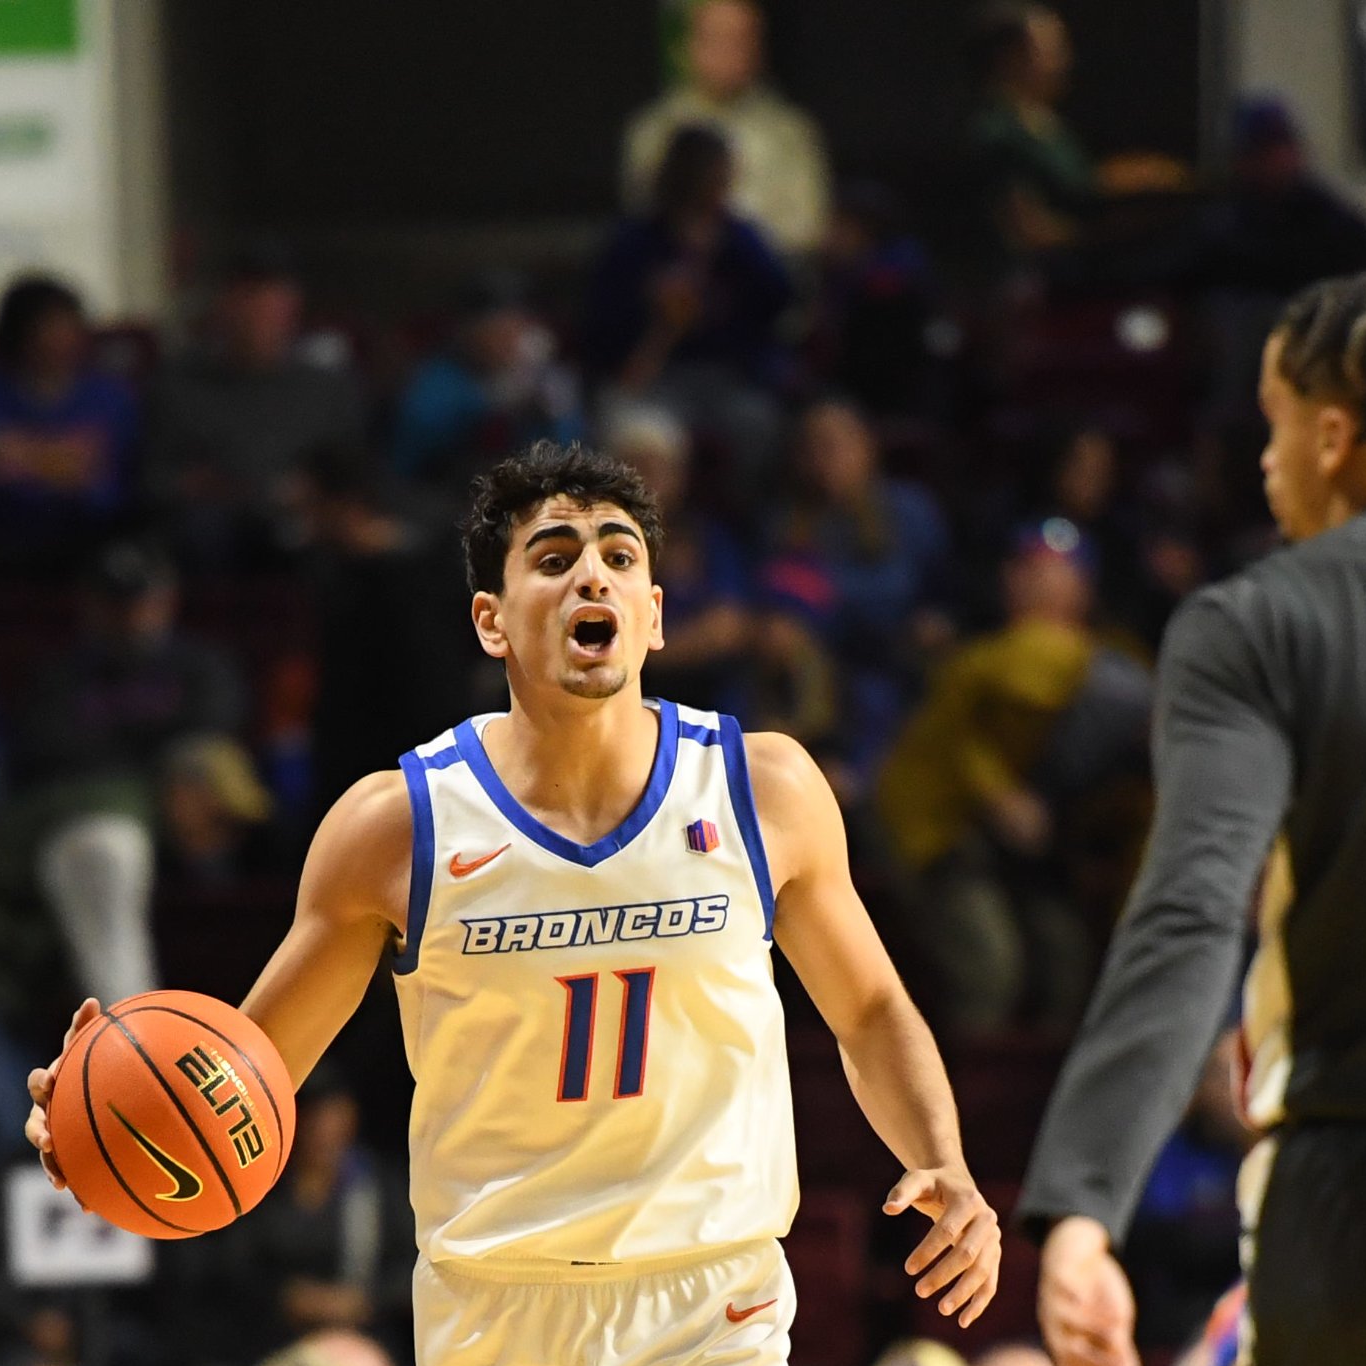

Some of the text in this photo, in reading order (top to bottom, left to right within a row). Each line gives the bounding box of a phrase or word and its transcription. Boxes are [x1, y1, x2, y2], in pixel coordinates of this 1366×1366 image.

[459, 894, 730, 955] BRONCOS
[554, 966, 657, 1104] 11
[174, 1044, 268, 1170] ELITE
